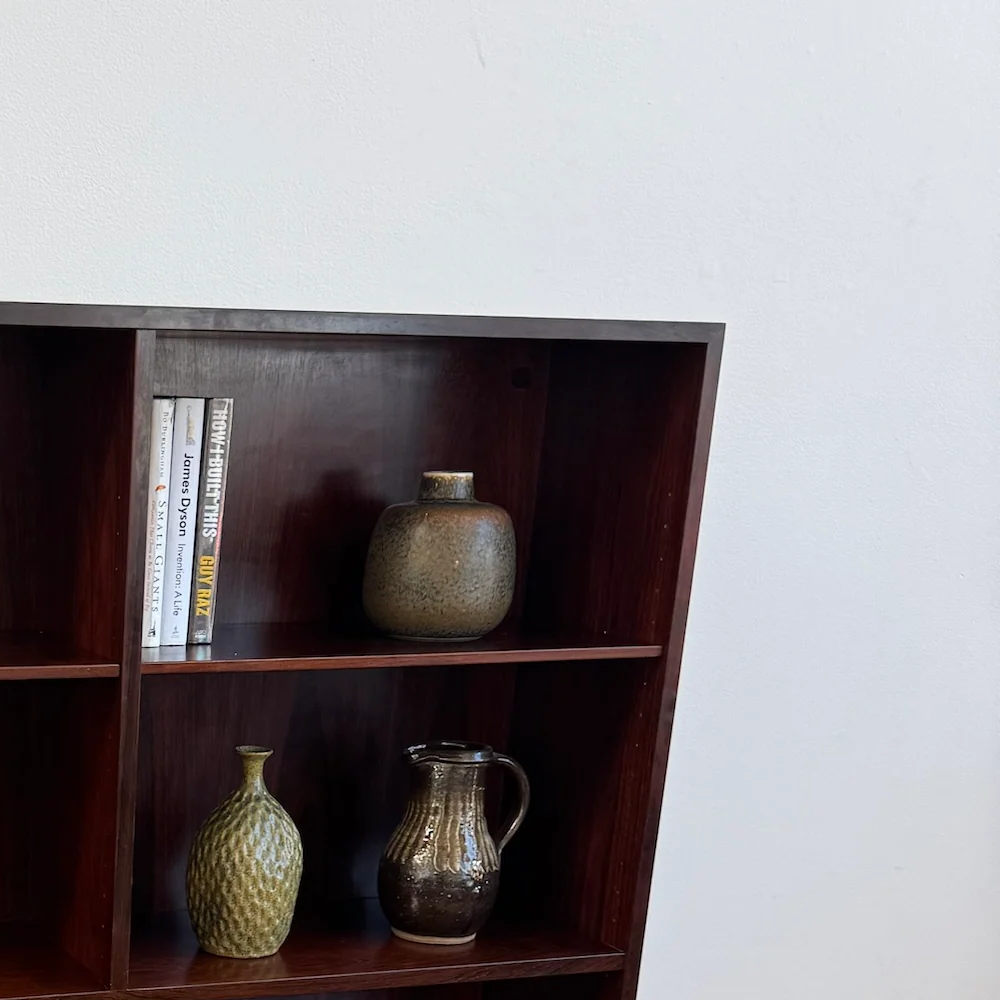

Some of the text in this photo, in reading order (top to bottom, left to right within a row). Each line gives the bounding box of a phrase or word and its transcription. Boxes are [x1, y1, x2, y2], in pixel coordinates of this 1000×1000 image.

[210, 410, 228, 446] HOW
[178, 453, 194, 537] James Dyson
[206, 458, 224, 498] BUILT
[202, 505, 220, 538] THIS
[152, 500, 166, 612] SMALL GIANTS
[175, 544, 186, 588] Invention:
[198, 556, 215, 586] GUY
[172, 600, 182, 616] Life
[196, 588, 212, 617] RAZ
